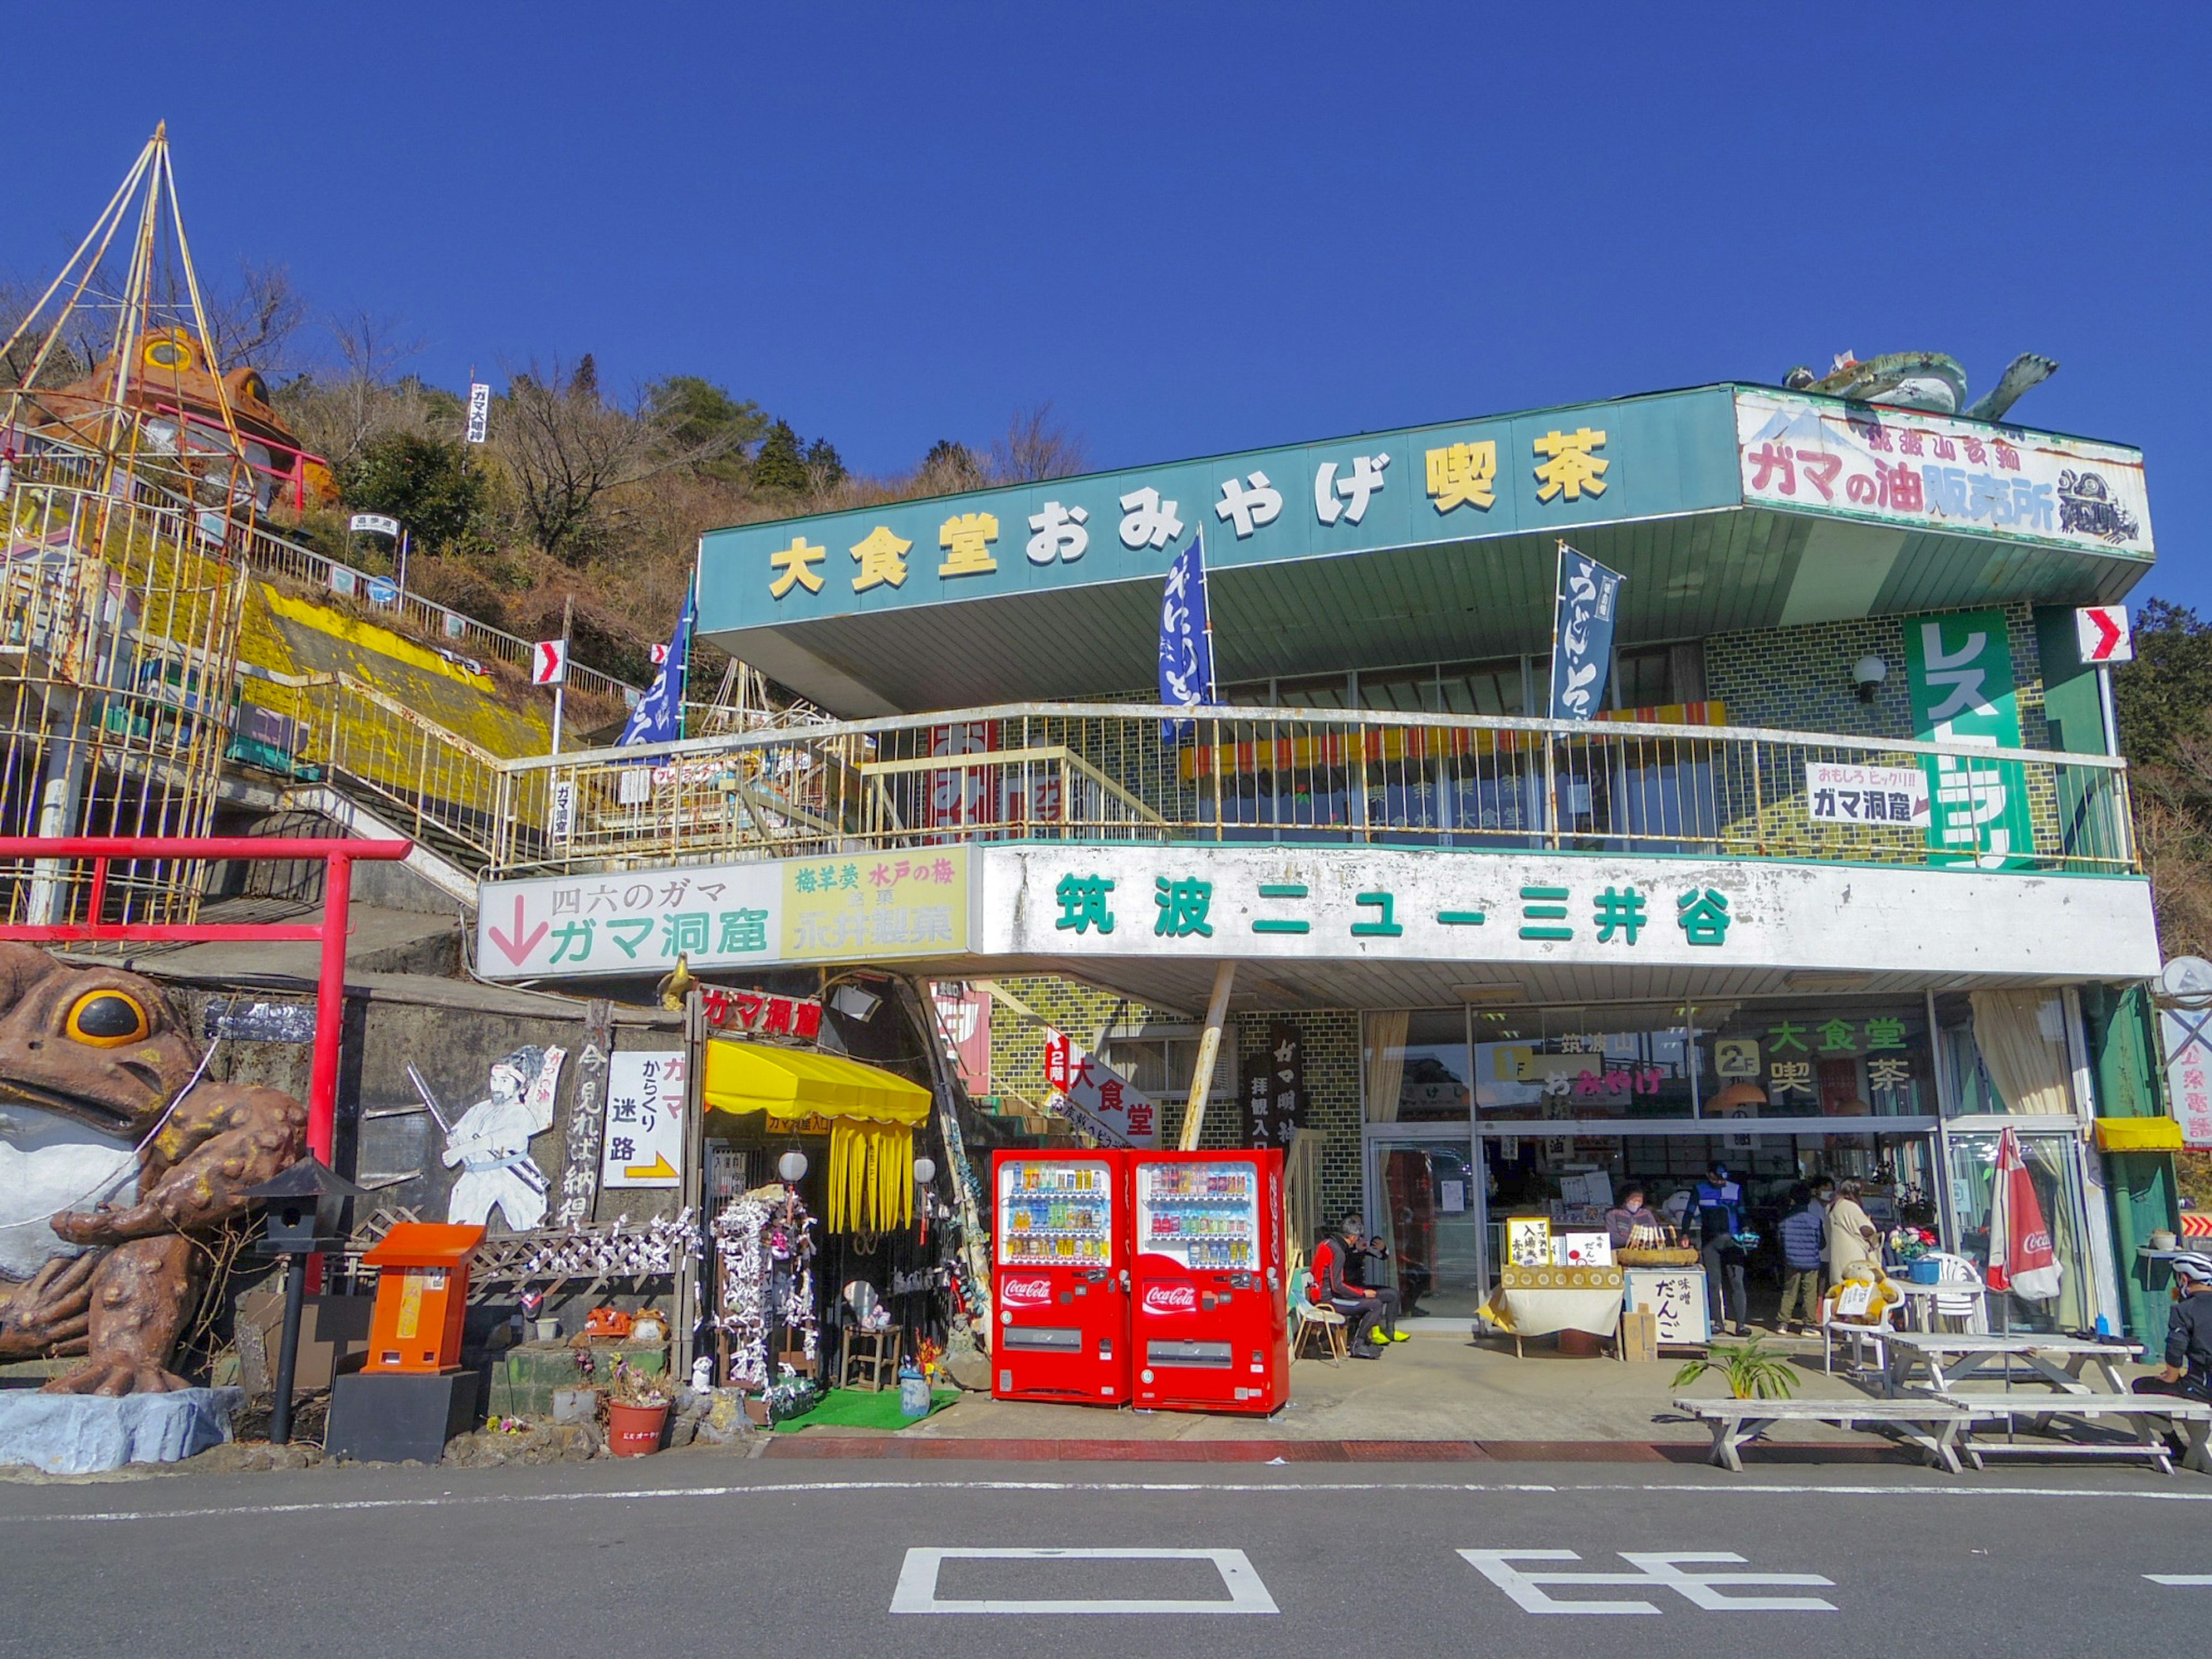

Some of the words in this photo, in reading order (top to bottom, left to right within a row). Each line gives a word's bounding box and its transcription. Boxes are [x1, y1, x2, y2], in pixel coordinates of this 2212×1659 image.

[470, 391, 486, 441] ガマ大明神
[1921, 622, 2010, 869] レストラン
[1819, 768, 1864, 783] おもしろ
[556, 786, 569, 832] ガマ洞窟
[1815, 788, 1911, 821] ガマ洞窟
[795, 863, 858, 893] 梅羊羹
[868, 858, 955, 887] 水戸の梅
[551, 878, 727, 916] 四六のガマ
[548, 907, 769, 964] ガマ洞窟
[1561, 1033, 1634, 1053] 筑波山
[1768, 1017, 1907, 1052] 大食堂
[1050, 1051, 1065, 1082] 2階
[1721, 1044, 1756, 1073] 2F
[1770, 1058, 1910, 1093] 喫茶
[642, 1060, 661, 1132] からくり
[1070, 1057, 1153, 1136] 大食堂
[1545, 1066, 1665, 1095] おみやげ
[609, 1097, 637, 1161] 迷路
[1251, 1077, 1269, 1150] 拝観入口
[1005, 1279, 1052, 1300] Coca-Cola
[1146, 1286, 1195, 1306] Coca-Cola
[1677, 1278, 1692, 1305] 味噌
[1655, 1279, 1680, 1339] だんご
